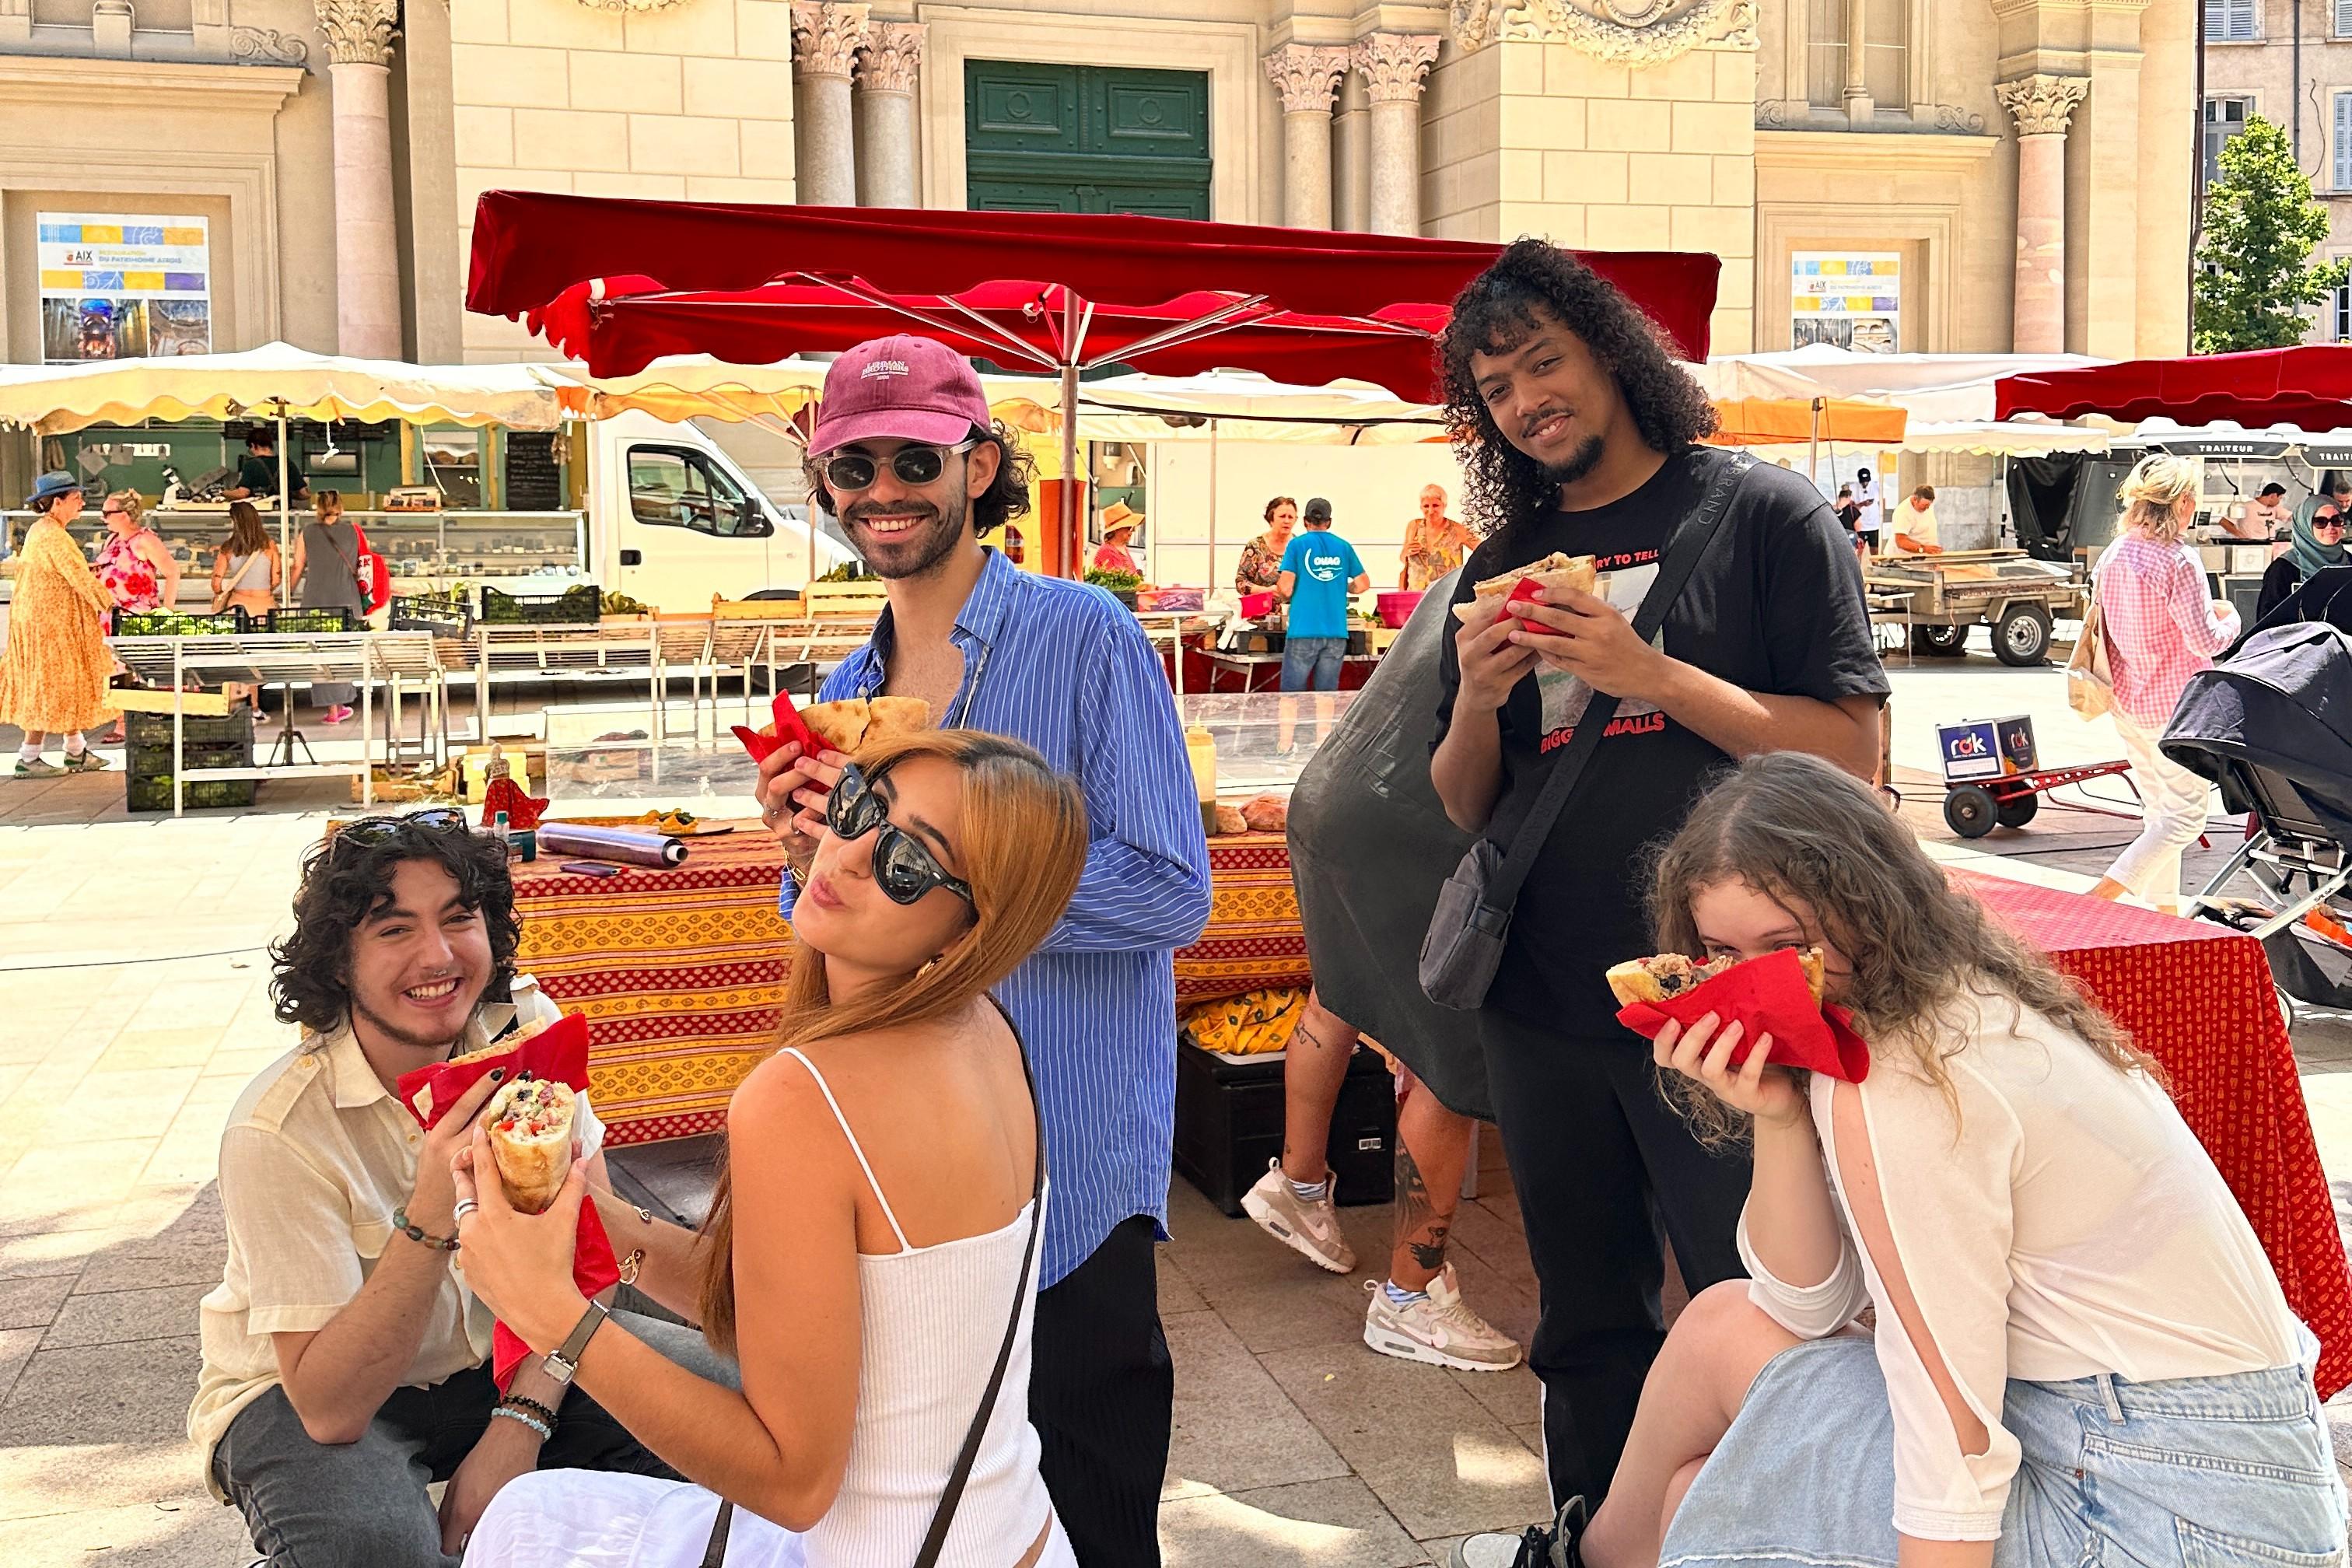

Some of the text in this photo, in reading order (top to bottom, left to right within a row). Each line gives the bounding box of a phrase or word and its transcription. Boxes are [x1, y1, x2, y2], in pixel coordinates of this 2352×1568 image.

[75, 250, 93, 261] AIX
[1596, 549, 1659, 569] RY TO TELL
[1541, 713, 1665, 754] BIGG MALLS
